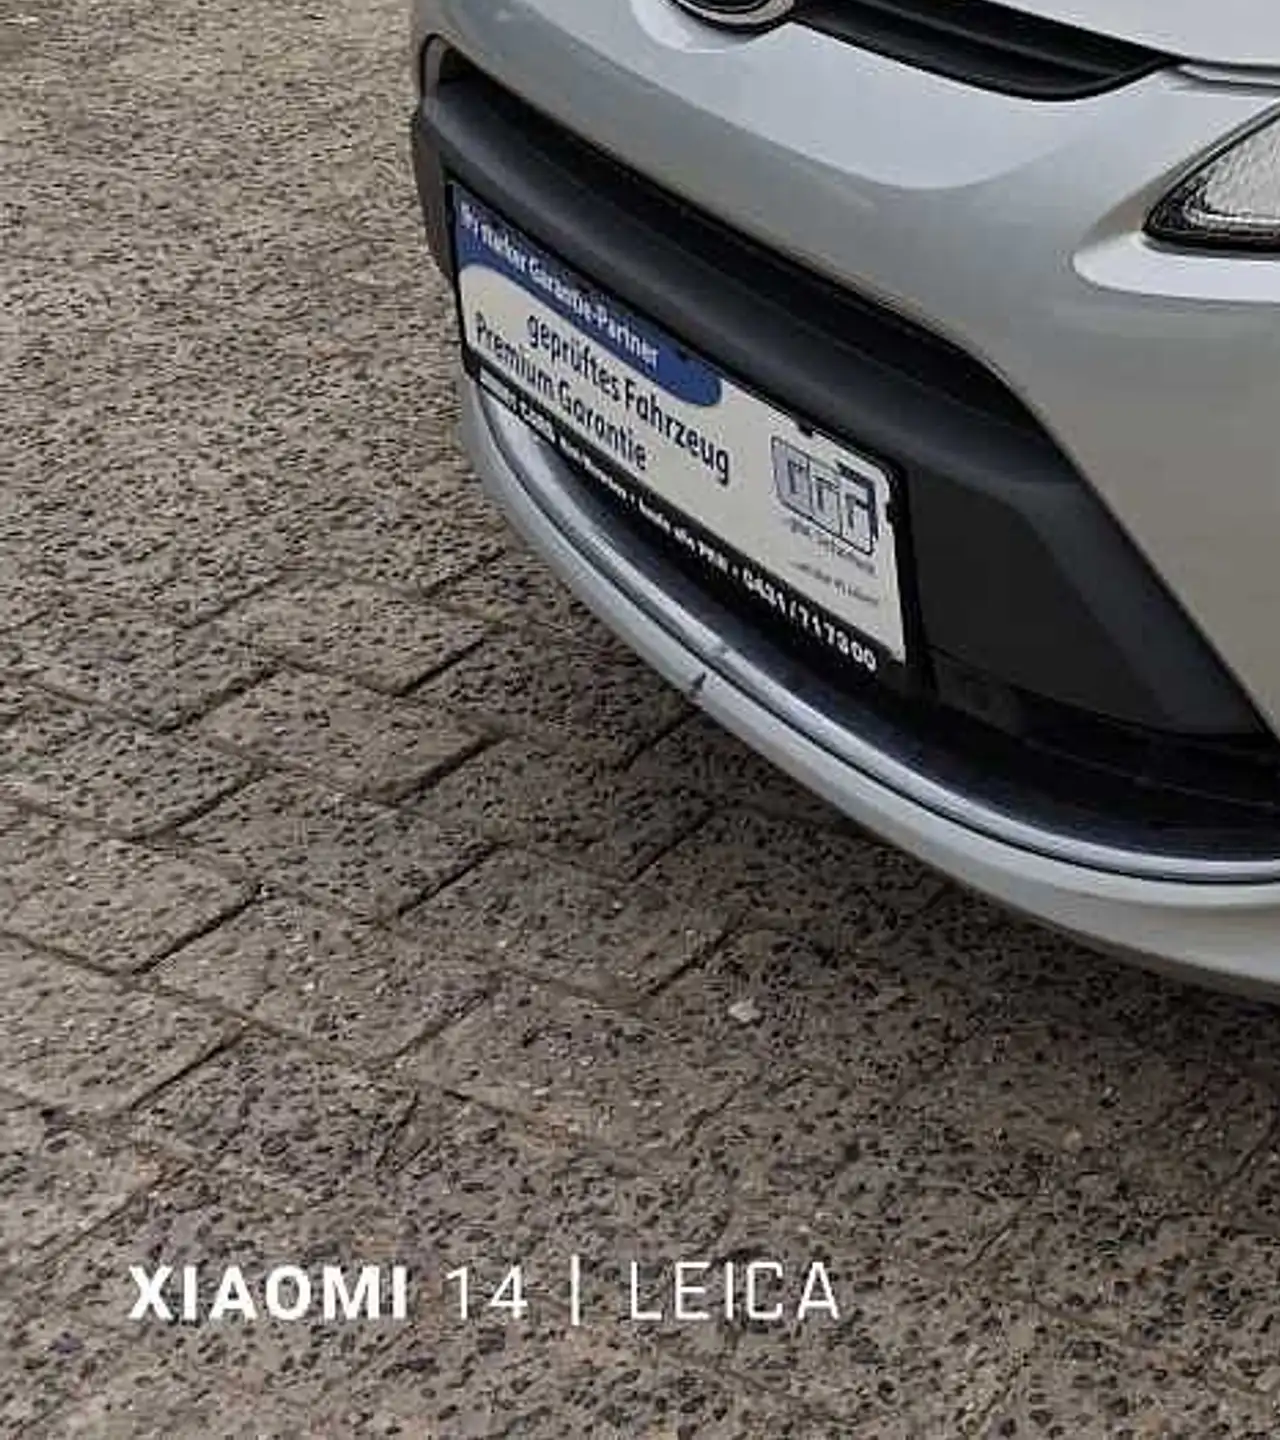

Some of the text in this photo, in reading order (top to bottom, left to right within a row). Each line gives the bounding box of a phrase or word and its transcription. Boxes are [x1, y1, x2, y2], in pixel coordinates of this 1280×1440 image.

[475, 311, 555, 400] Premium
[559, 380, 647, 471] Garantie
[526, 315, 621, 403] geprüftes
[625, 378, 730, 486] Fahrzeug
